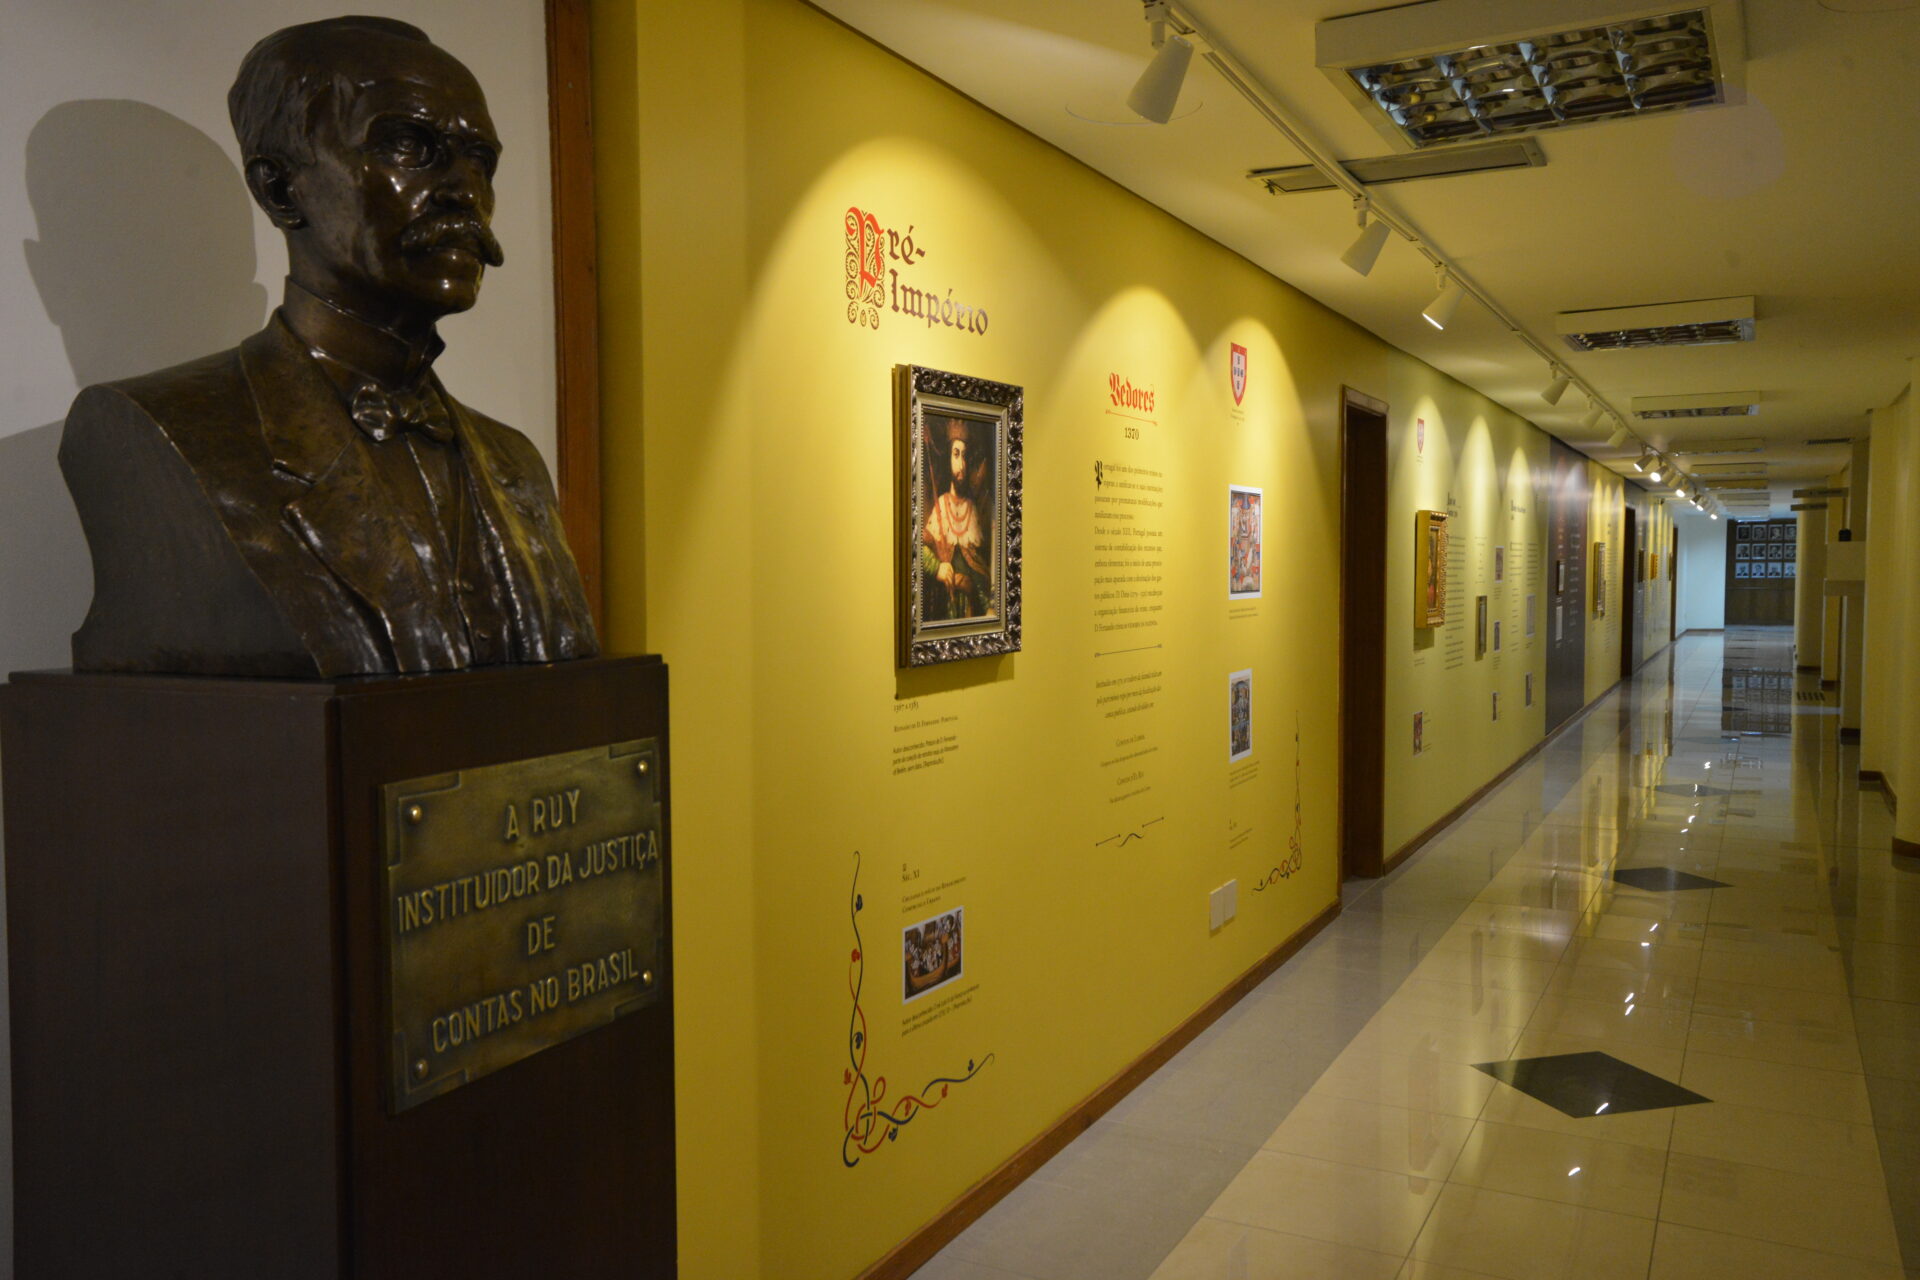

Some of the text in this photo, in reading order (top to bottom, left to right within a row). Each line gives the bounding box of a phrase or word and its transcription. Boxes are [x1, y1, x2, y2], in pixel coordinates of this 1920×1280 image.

[888, 268, 989, 337] Império
[1109, 372, 1155, 414] Vedores
[1124, 427, 1140, 441] 1370
[506, 789, 582, 840] A RUY
[398, 830, 658, 933] INSTITUIDOR DA JUSTIÇA
[528, 917, 556, 955] DE
[433, 949, 638, 1052] CONTAS NO BRASIL
